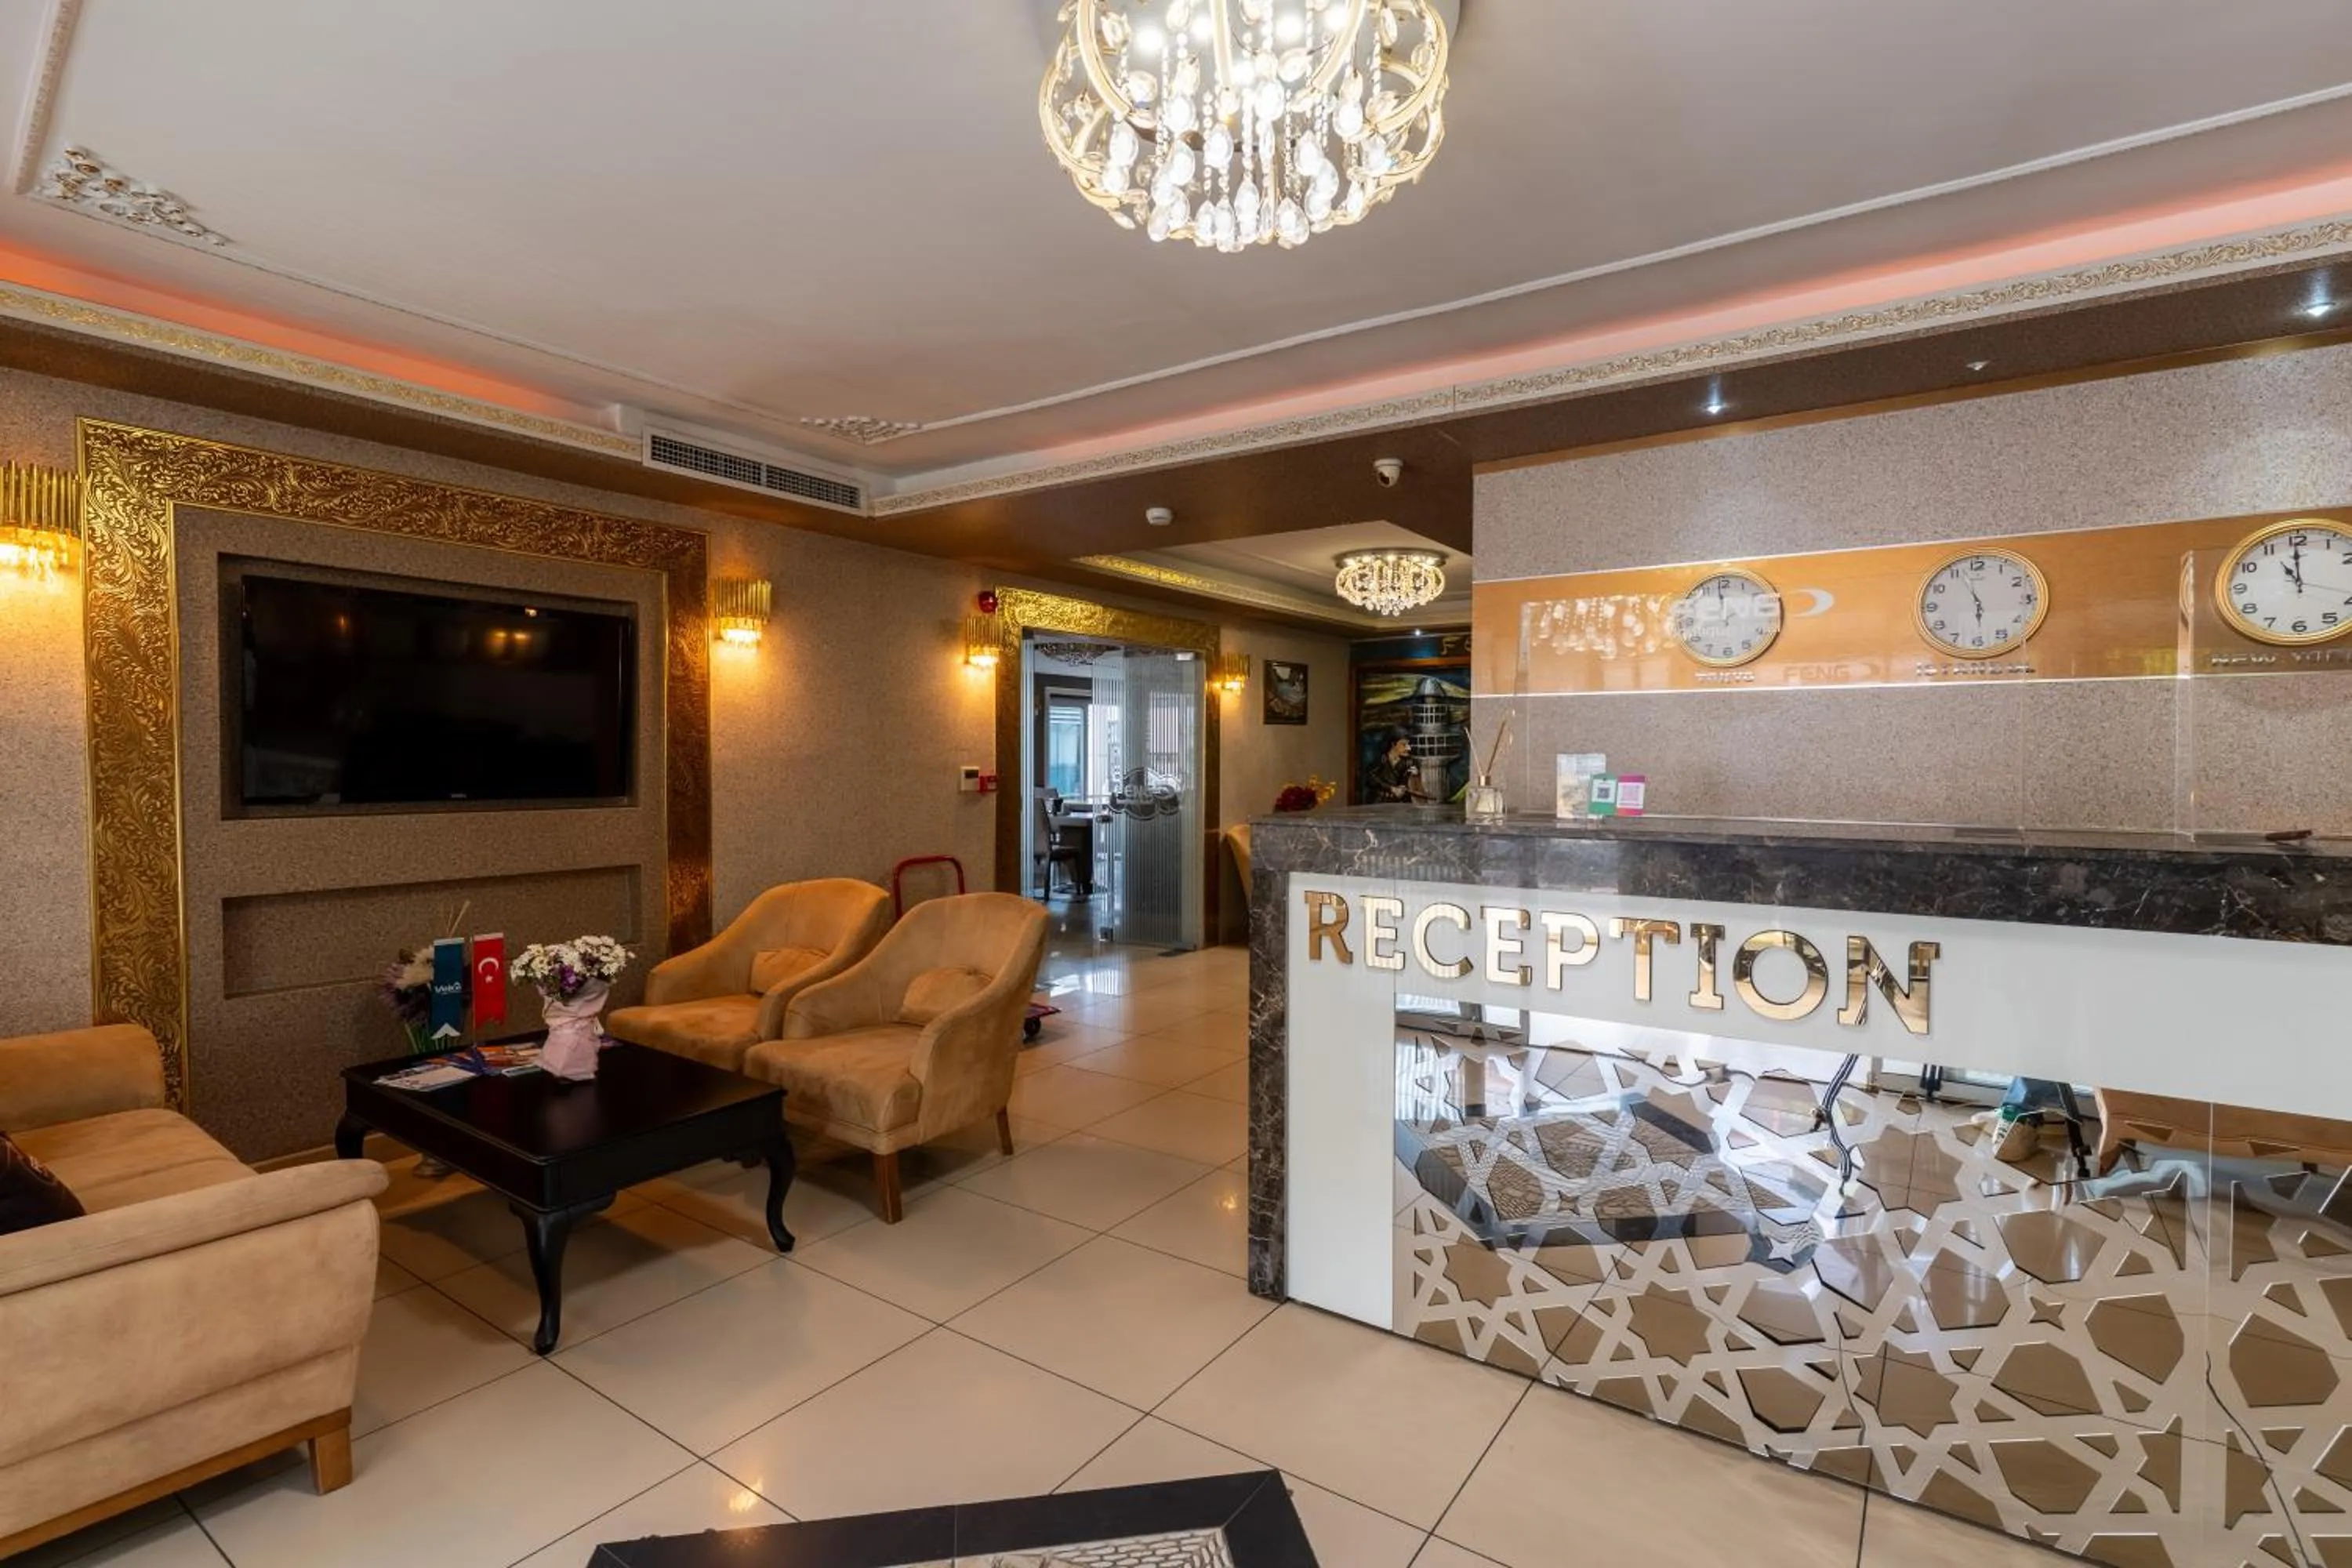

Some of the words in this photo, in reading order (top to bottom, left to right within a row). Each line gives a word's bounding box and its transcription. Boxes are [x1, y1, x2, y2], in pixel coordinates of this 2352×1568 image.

[2288, 535, 2307, 547] 12
[2326, 539, 2331, 550] 1
[2264, 544, 2274, 555] 11
[2342, 552, 2352, 565] 2
[1969, 561, 1985, 572] 12
[2241, 561, 2257, 573] 10
[1950, 568, 1959, 579] 11
[2012, 576, 2022, 588] 2
[1933, 583, 1946, 594] 10
[2233, 583, 2248, 594] 9
[1926, 601, 1938, 613] 9
[2241, 603, 2258, 615] 8
[2263, 617, 2277, 628] 7
[2321, 612, 2338, 624] 5
[2292, 621, 2307, 633] 6
[1950, 632, 1959, 643] 7
[1972, 636, 1984, 647] 6
[1722, 647, 1733, 657] 6
[1304, 890, 1941, 1035] RECEPTION
